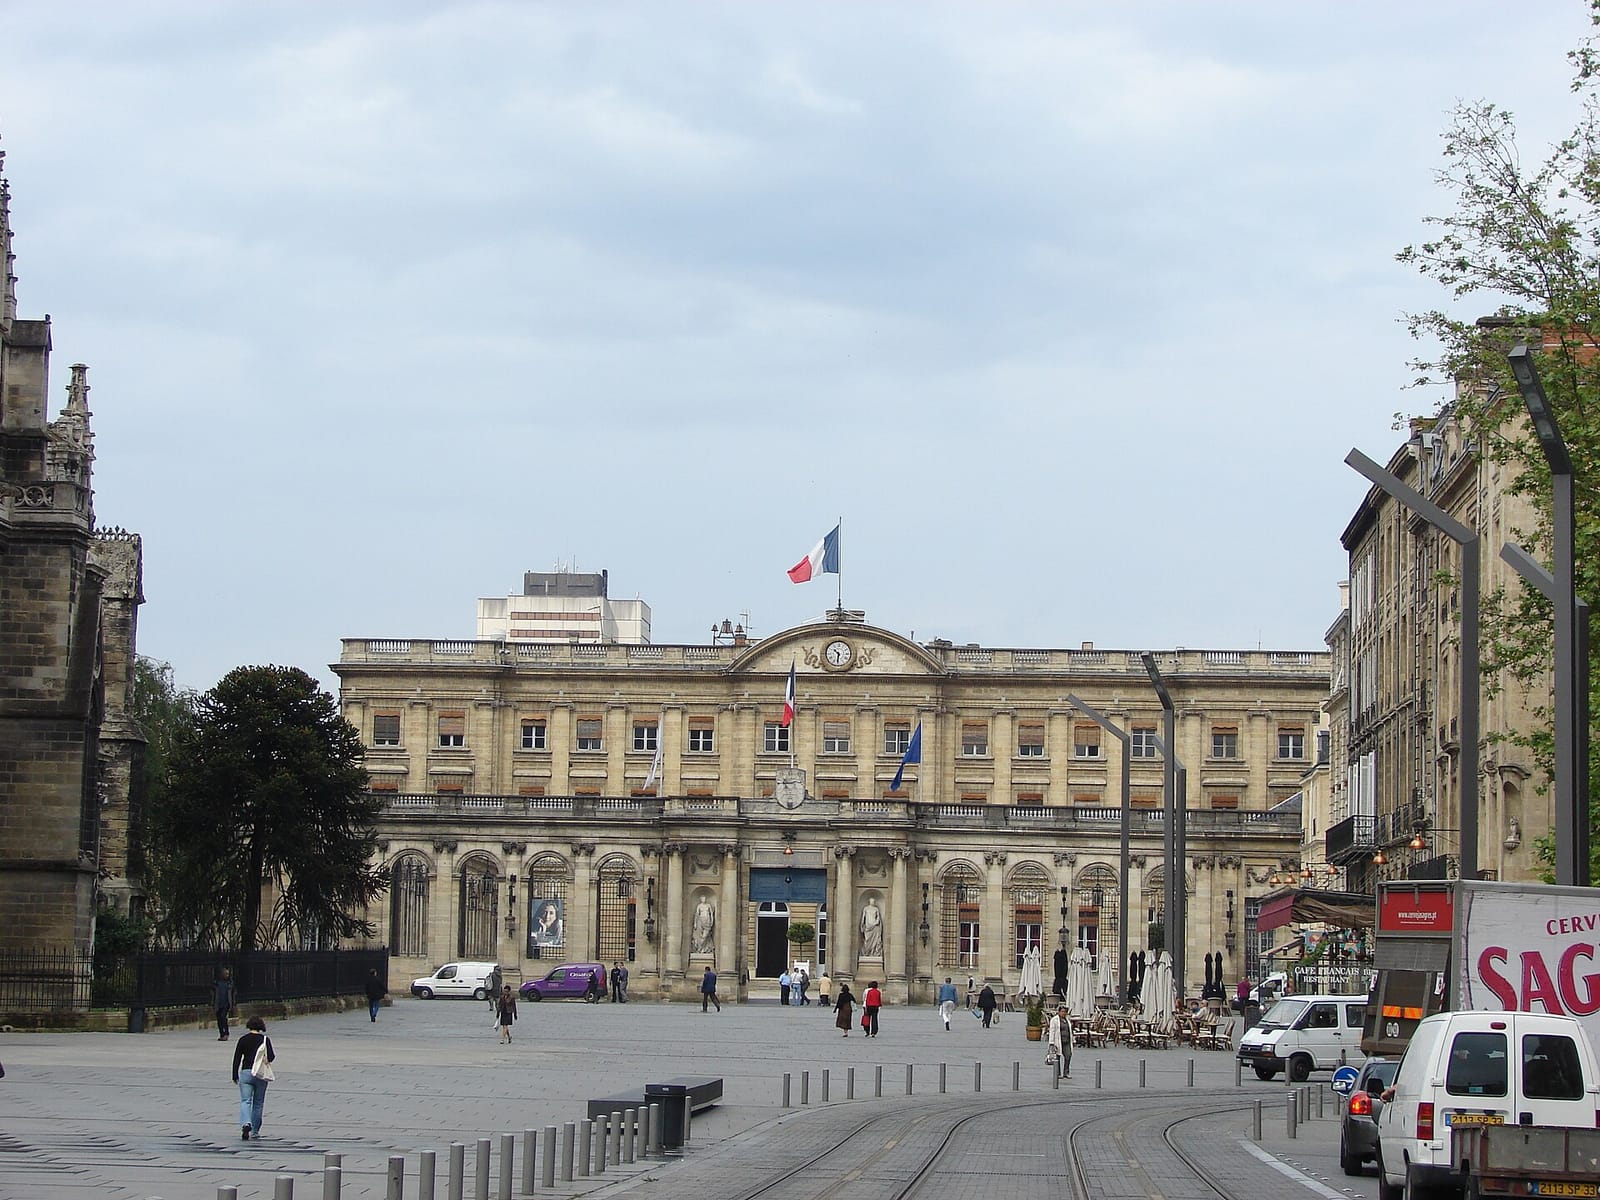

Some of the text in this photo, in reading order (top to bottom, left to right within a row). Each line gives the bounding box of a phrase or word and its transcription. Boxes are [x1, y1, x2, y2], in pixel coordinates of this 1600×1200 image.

[1546, 914, 1600, 936] CERV
[1303, 975, 1351, 984] RESTAURANT
[1477, 942, 1600, 1016] SAG
[1540, 1183, 1596, 1196] 2113 SP 33
